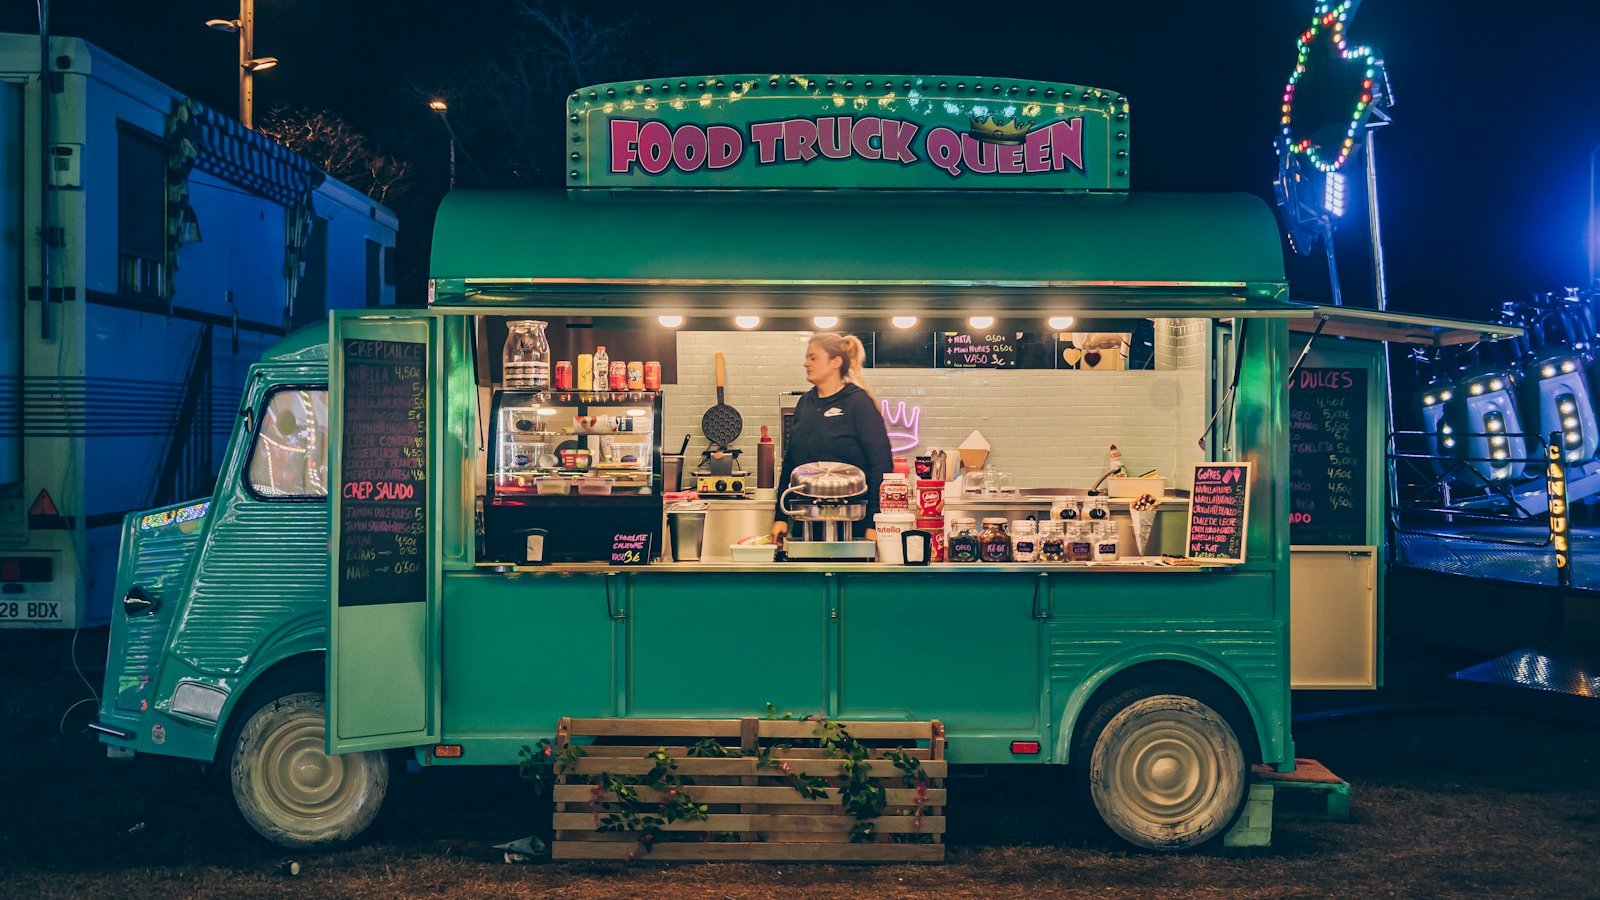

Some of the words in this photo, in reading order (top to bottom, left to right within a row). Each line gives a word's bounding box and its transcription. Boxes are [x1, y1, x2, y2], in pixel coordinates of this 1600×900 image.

[608, 117, 744, 175] FOOD
[750, 115, 920, 165] TRUCK
[925, 117, 1085, 177] QUEEN
[964, 354, 988, 364] VASO
[1300, 370, 1353, 388] DULCES
[343, 481, 373, 499] CREP
[374, 482, 414, 501] SALADO
[28, 602, 58, 618] BDX
